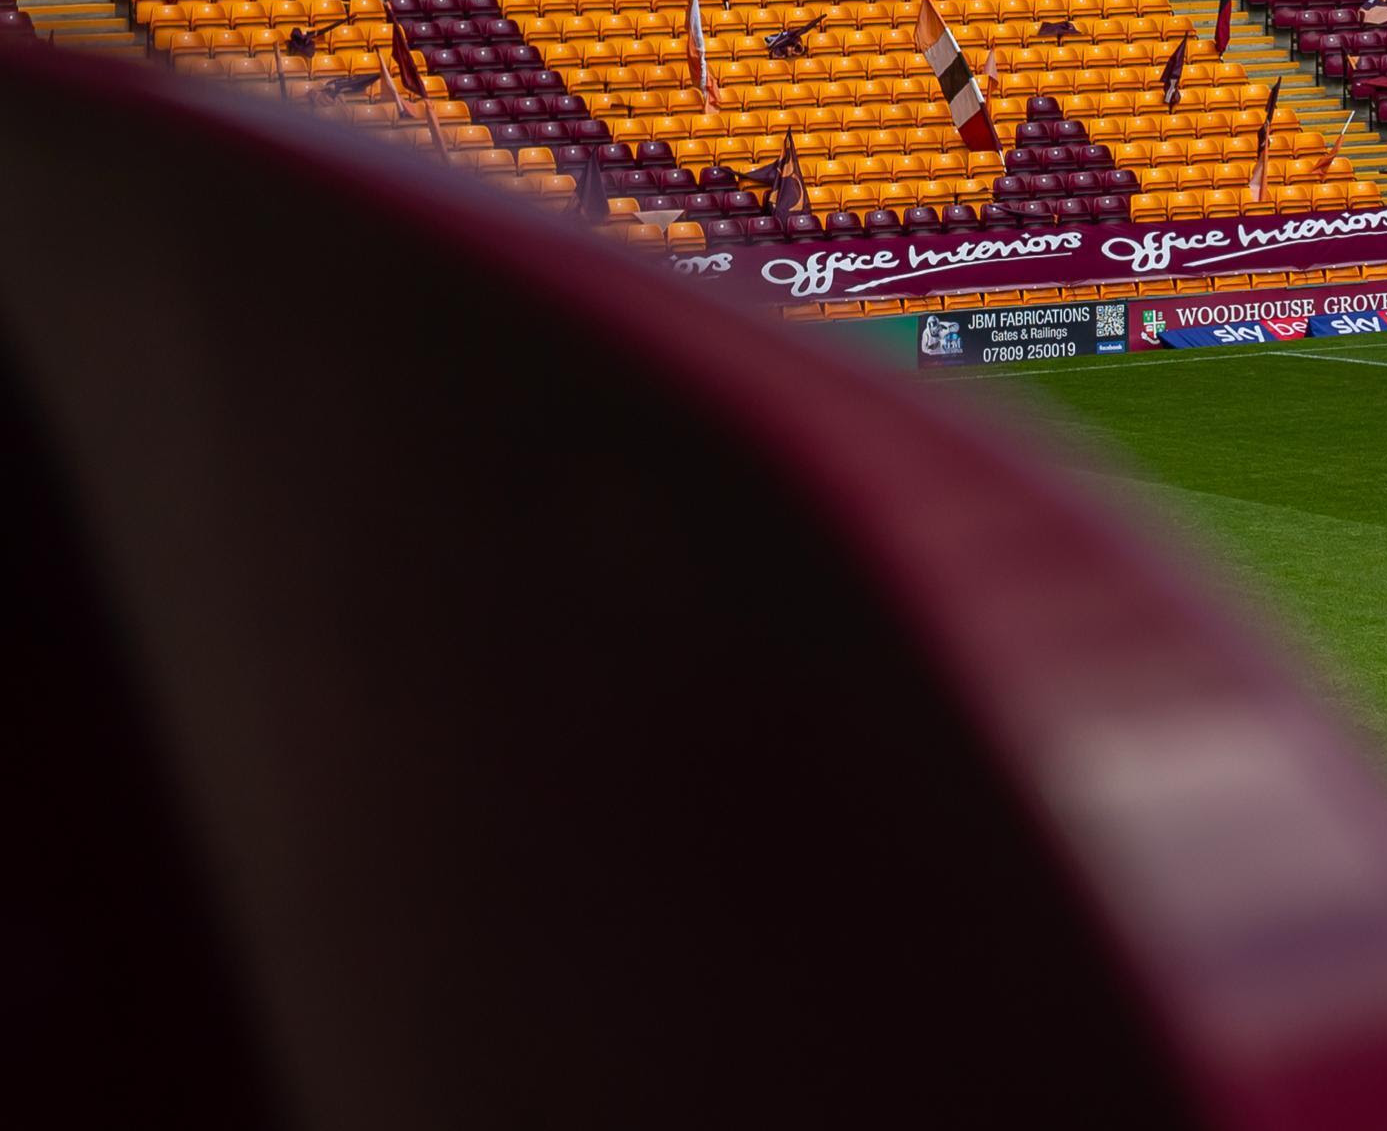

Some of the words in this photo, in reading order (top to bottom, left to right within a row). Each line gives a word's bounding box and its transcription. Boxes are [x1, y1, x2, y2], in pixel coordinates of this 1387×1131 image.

[1101, 230, 1231, 272] Office
[761, 251, 899, 297] Office
[909, 230, 1082, 268] Interiors
[968, 314, 996, 329] JBM
[1000, 307, 1090, 328] FABRICATIONS
[1176, 299, 1315, 326] WOODHOUSE
[991, 329, 1019, 342] Gates
[1021, 329, 1029, 341] &
[1030, 327, 1067, 341] Railings
[1213, 325, 1265, 343] sky
[1331, 315, 1381, 334] sky
[983, 346, 1024, 363] 07809
[1027, 342, 1076, 359] 250019
